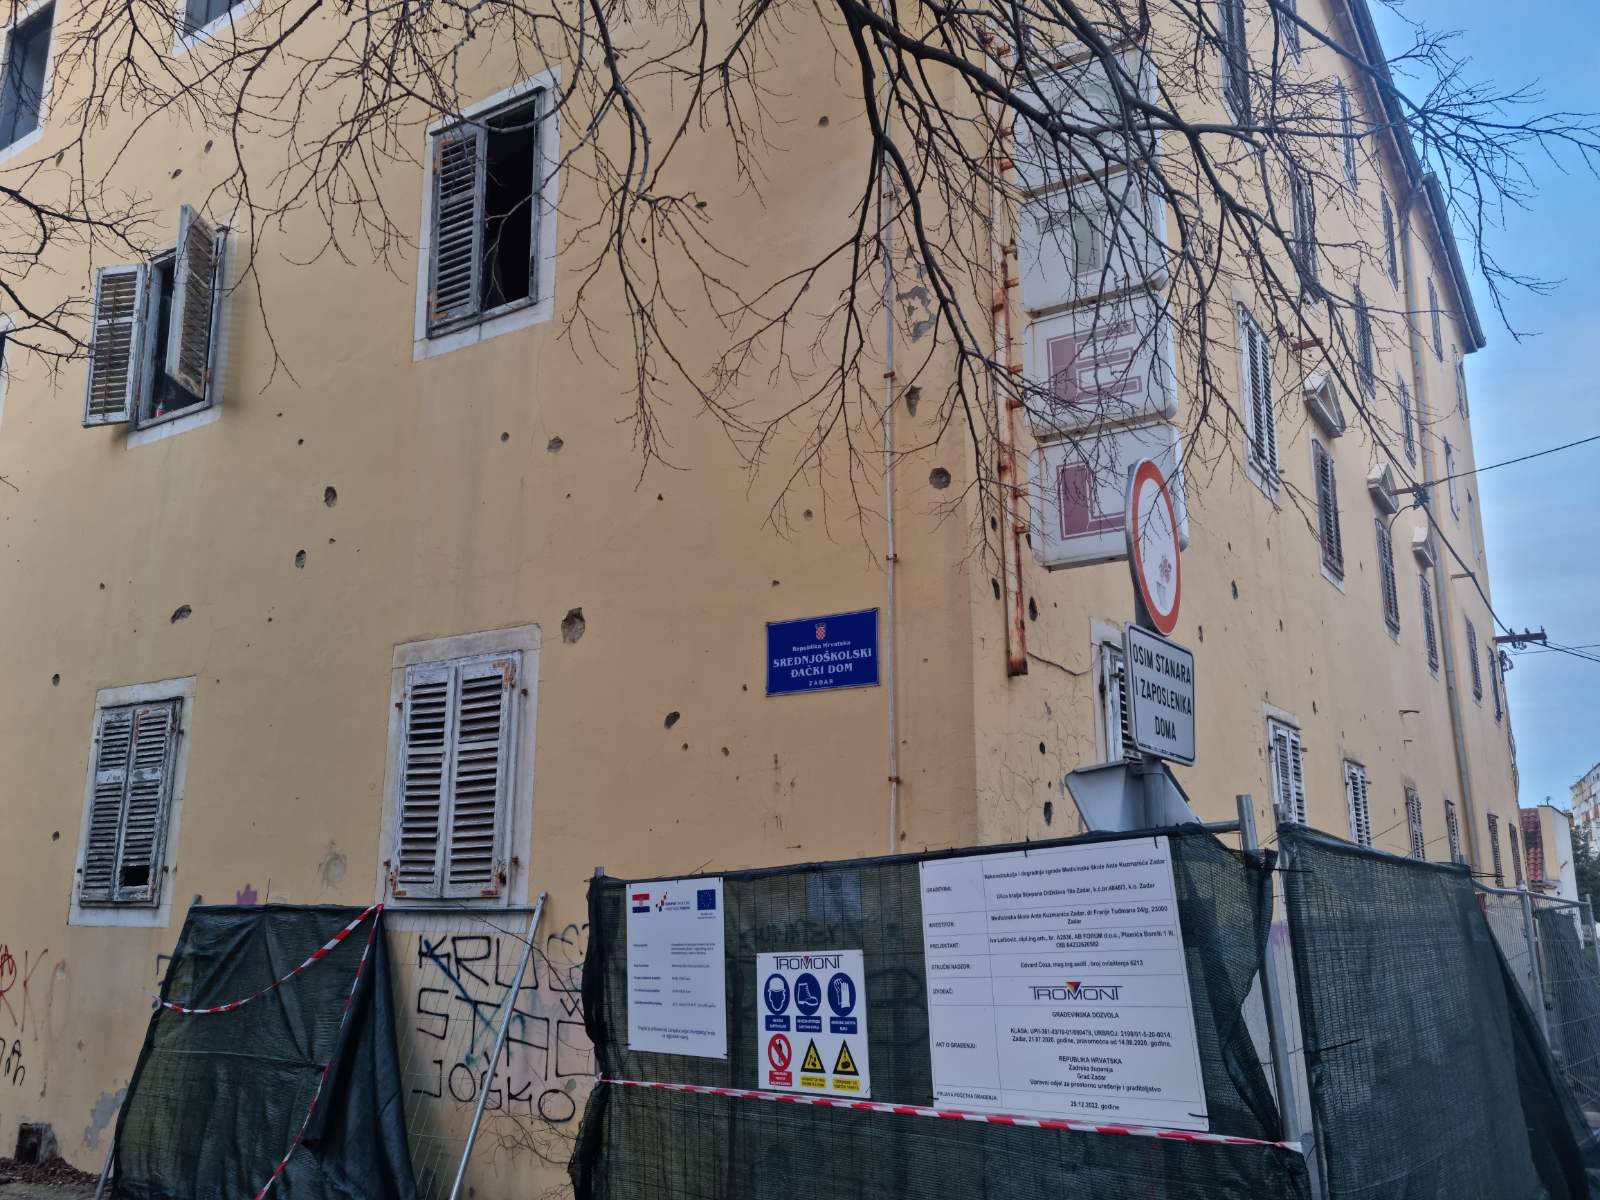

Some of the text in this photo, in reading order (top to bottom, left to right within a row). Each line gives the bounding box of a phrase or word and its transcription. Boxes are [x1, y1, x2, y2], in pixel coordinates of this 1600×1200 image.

[792, 640, 851, 652] Republika Hrvatska
[773, 647, 872, 668] SREDNJOŠKOLSKI
[1132, 643, 1191, 684] OSIM STANARA
[791, 662, 853, 678] ĐAČKI DOM
[808, 679, 834, 687] ZADAR
[1134, 676, 1192, 716] I ZAPOSLENIKA
[1154, 715, 1177, 741] DOMA
[1149, 858, 1166, 866] Zadar
[772, 954, 843, 970] TROMONT
[1029, 984, 1124, 1001] TROMONT
[1091, 1011, 1120, 1019] DOZVOLA
[1058, 1055, 1123, 1065] REPUBLIKA HRVATSKA
[1076, 1073, 1106, 1081] Grad Zadar
